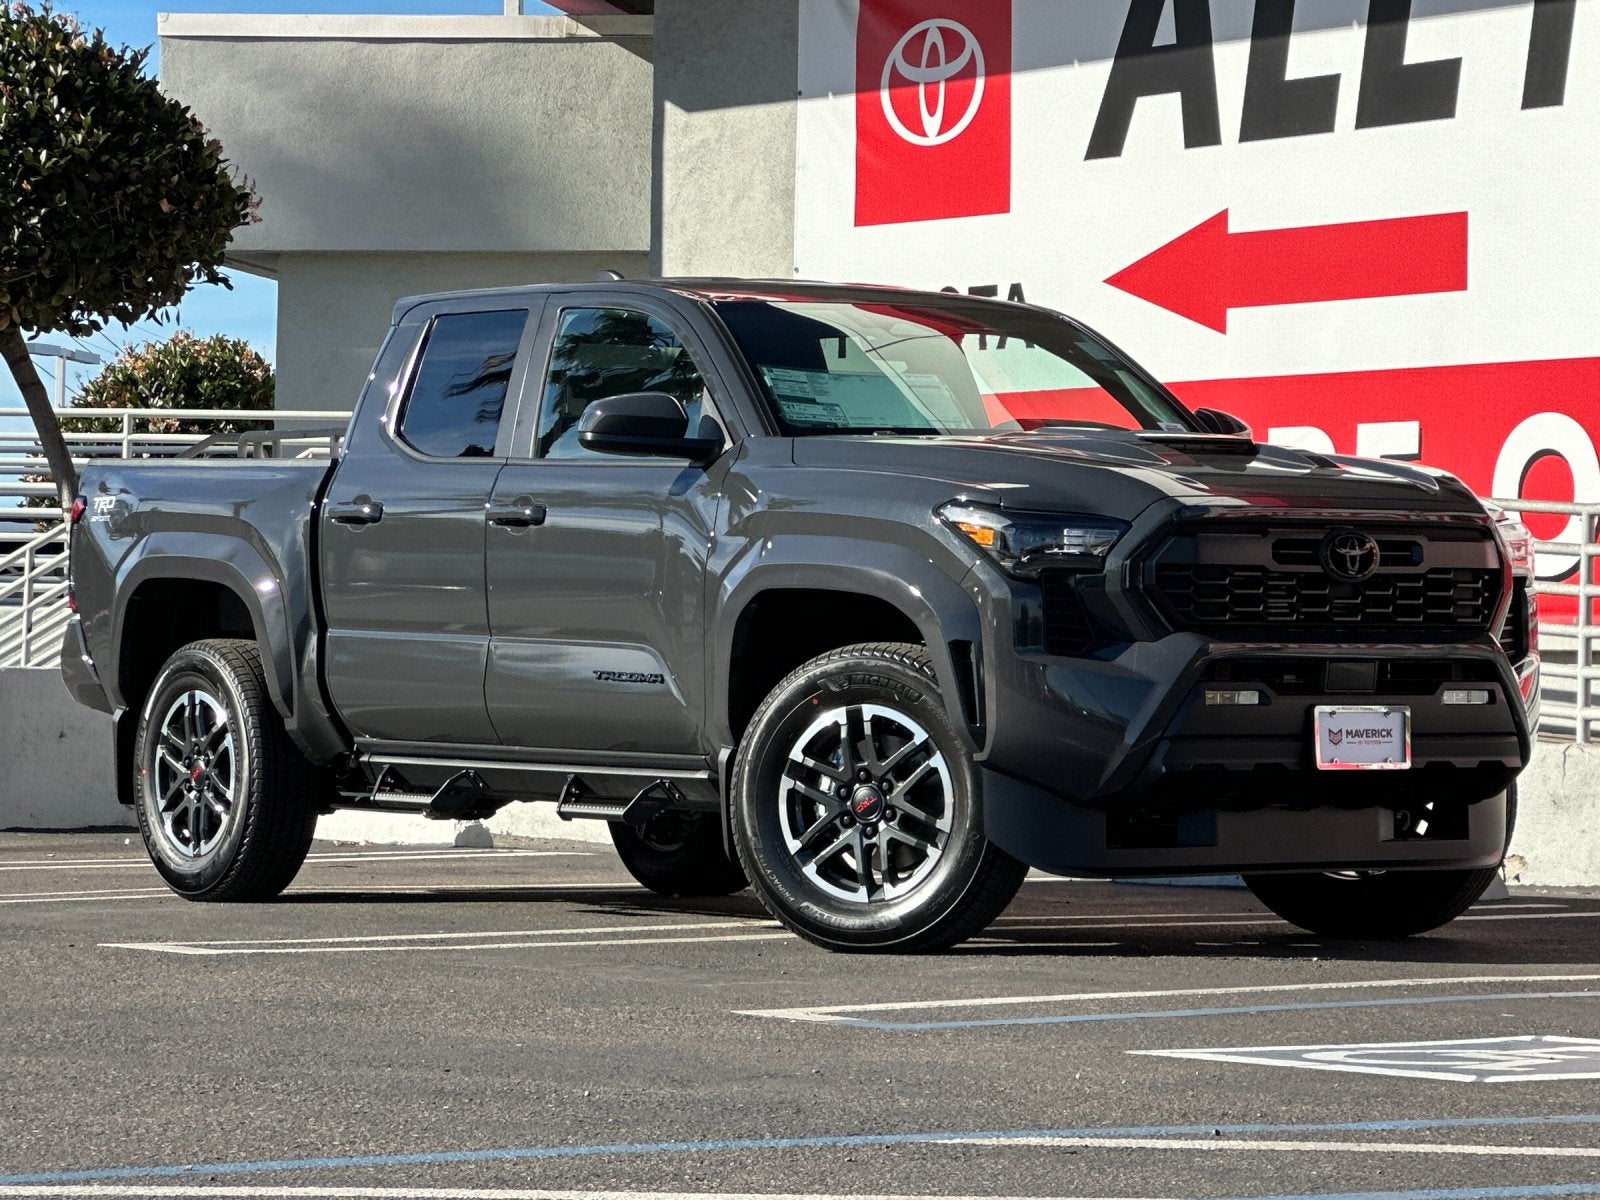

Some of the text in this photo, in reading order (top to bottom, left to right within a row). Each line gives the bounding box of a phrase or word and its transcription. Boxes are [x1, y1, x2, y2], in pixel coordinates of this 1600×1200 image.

[93, 496, 116, 513] TRD
[592, 670, 665, 684] TACOMA
[1345, 728, 1393, 739] MAVERICK
[763, 868, 795, 902] PRIMACY
